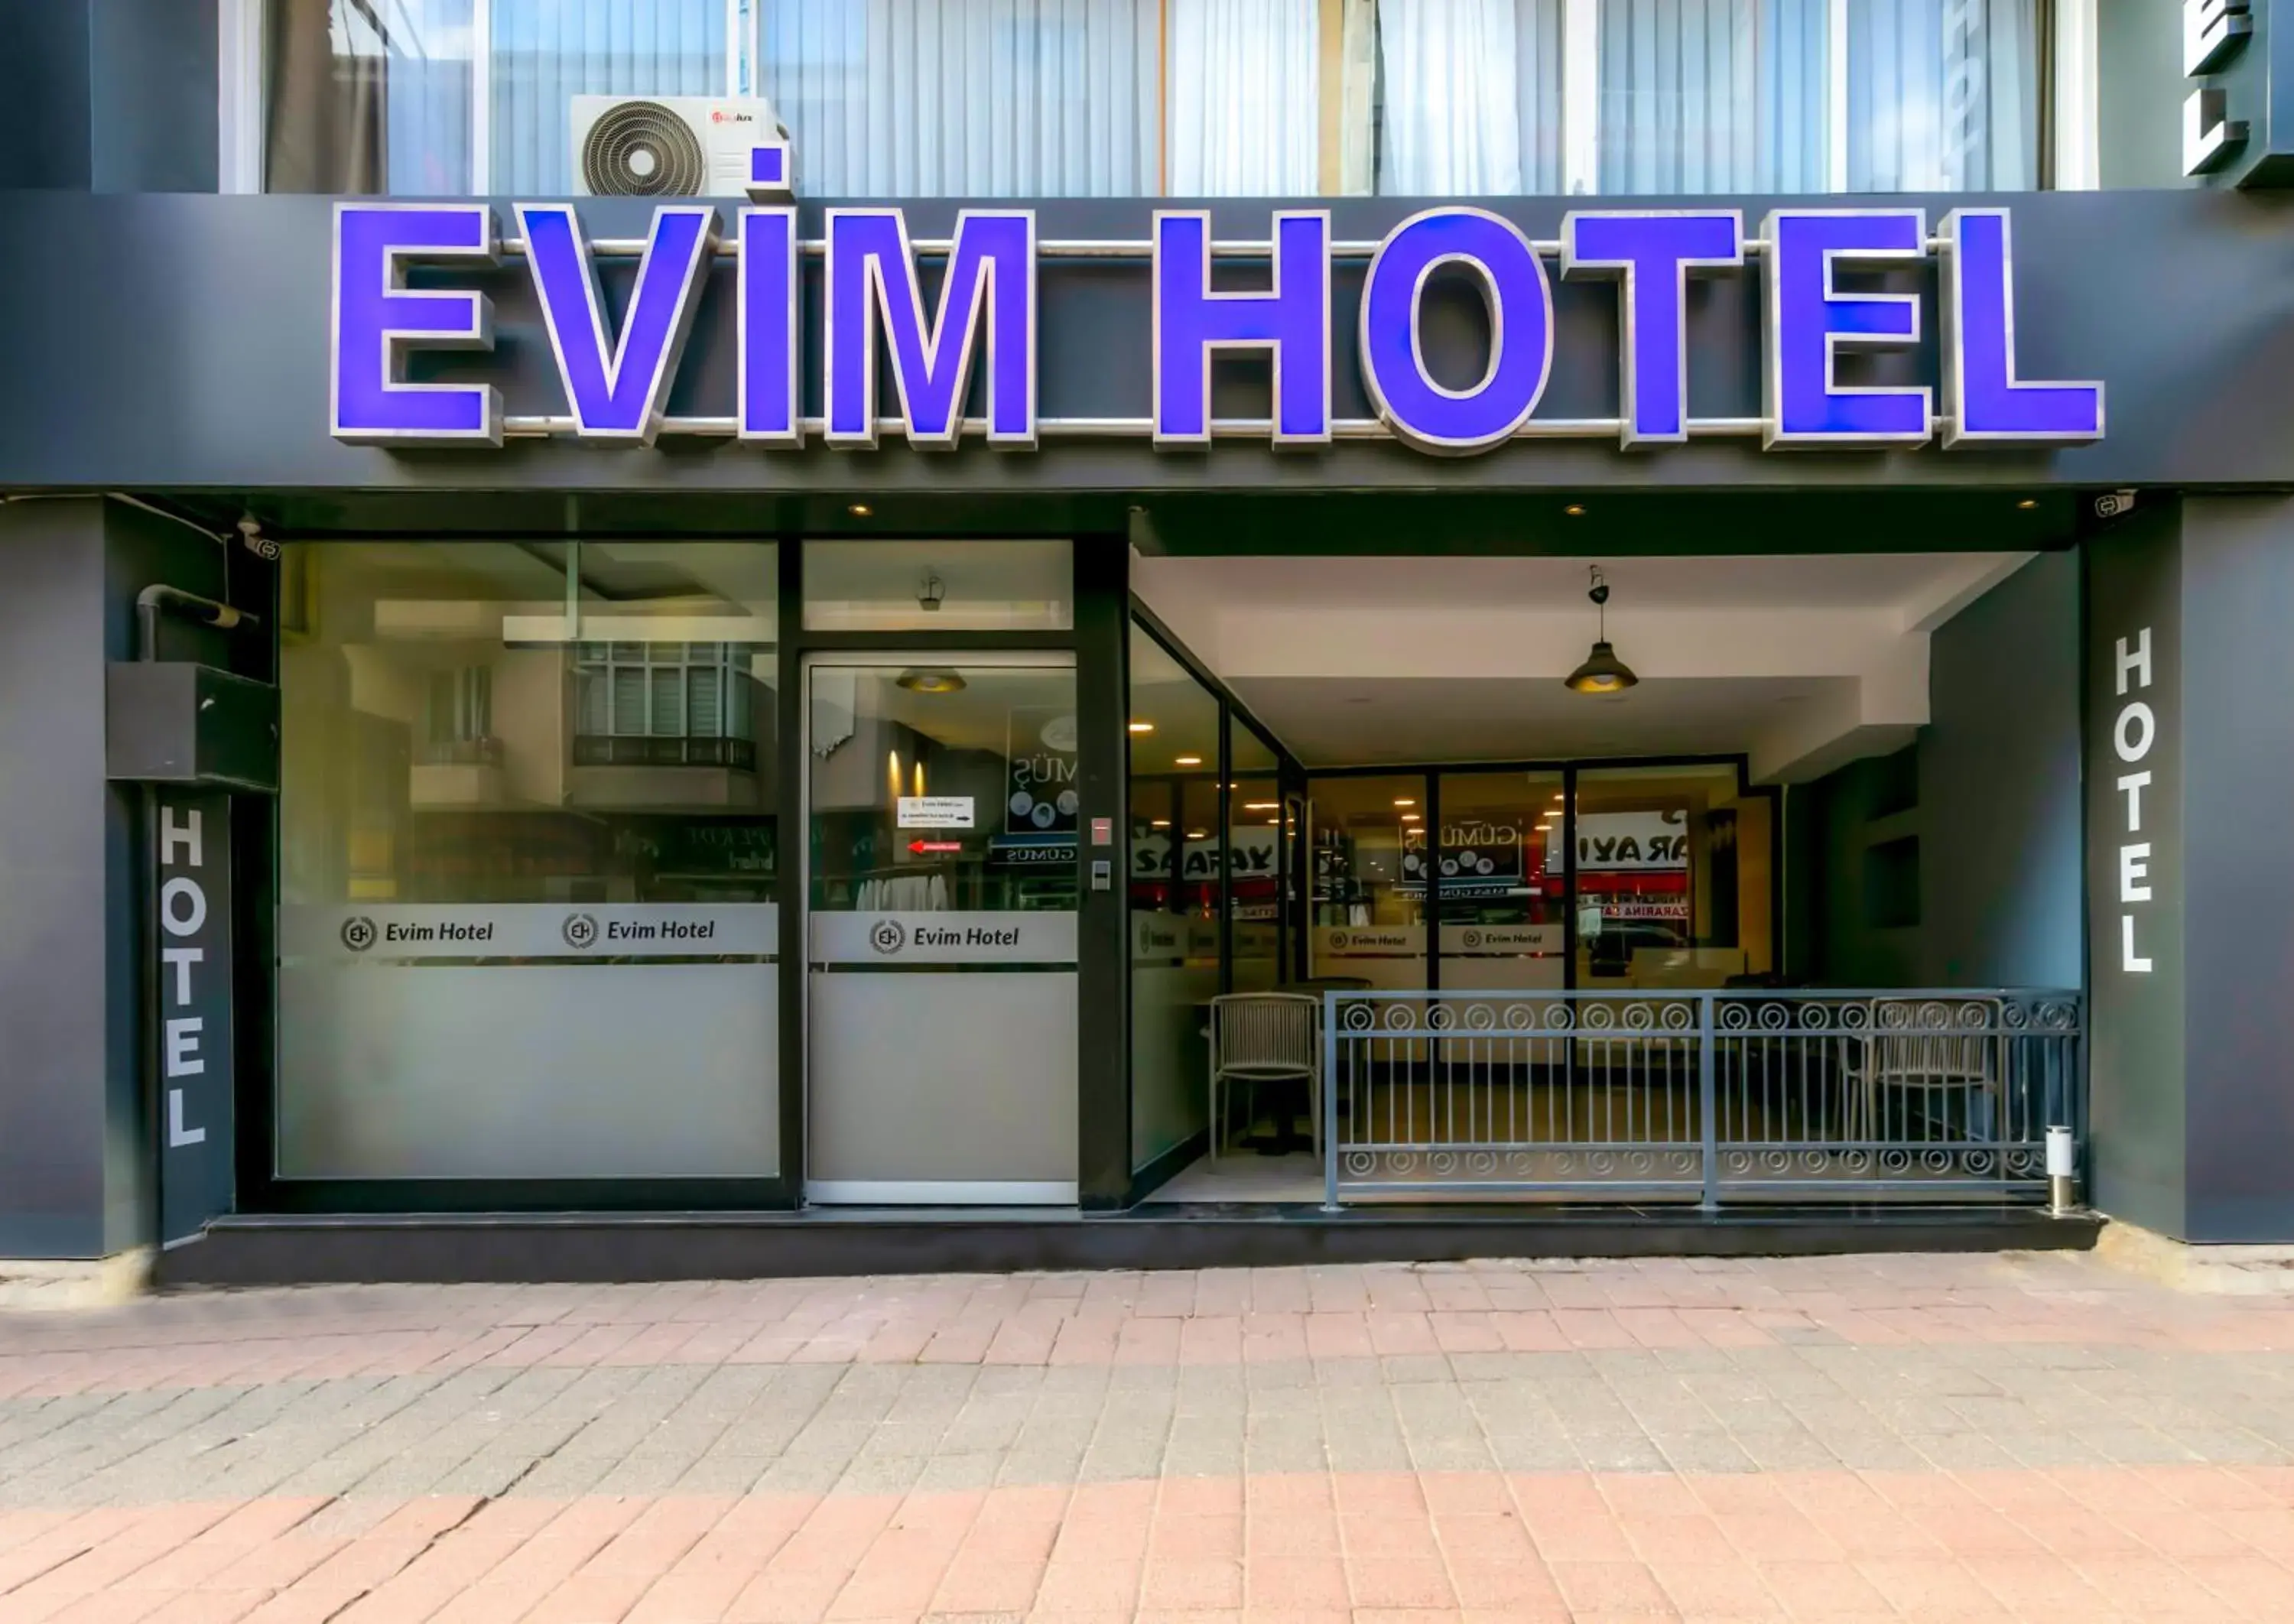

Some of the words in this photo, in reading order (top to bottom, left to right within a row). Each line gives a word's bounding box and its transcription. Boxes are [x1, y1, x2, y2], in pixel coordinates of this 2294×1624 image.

[330, 141, 1038, 448] EVİM
[1152, 206, 2106, 450] HOTEL
[2114, 625, 2156, 973] HOTEL
[160, 805, 207, 1148] HOTEL
[385, 922, 434, 941] Evim
[439, 922, 494, 940] Hotel
[607, 921, 656, 940] Evim
[660, 920, 715, 940] Hotel
[914, 927, 962, 946] Evim
[966, 927, 1020, 946] Hotel
